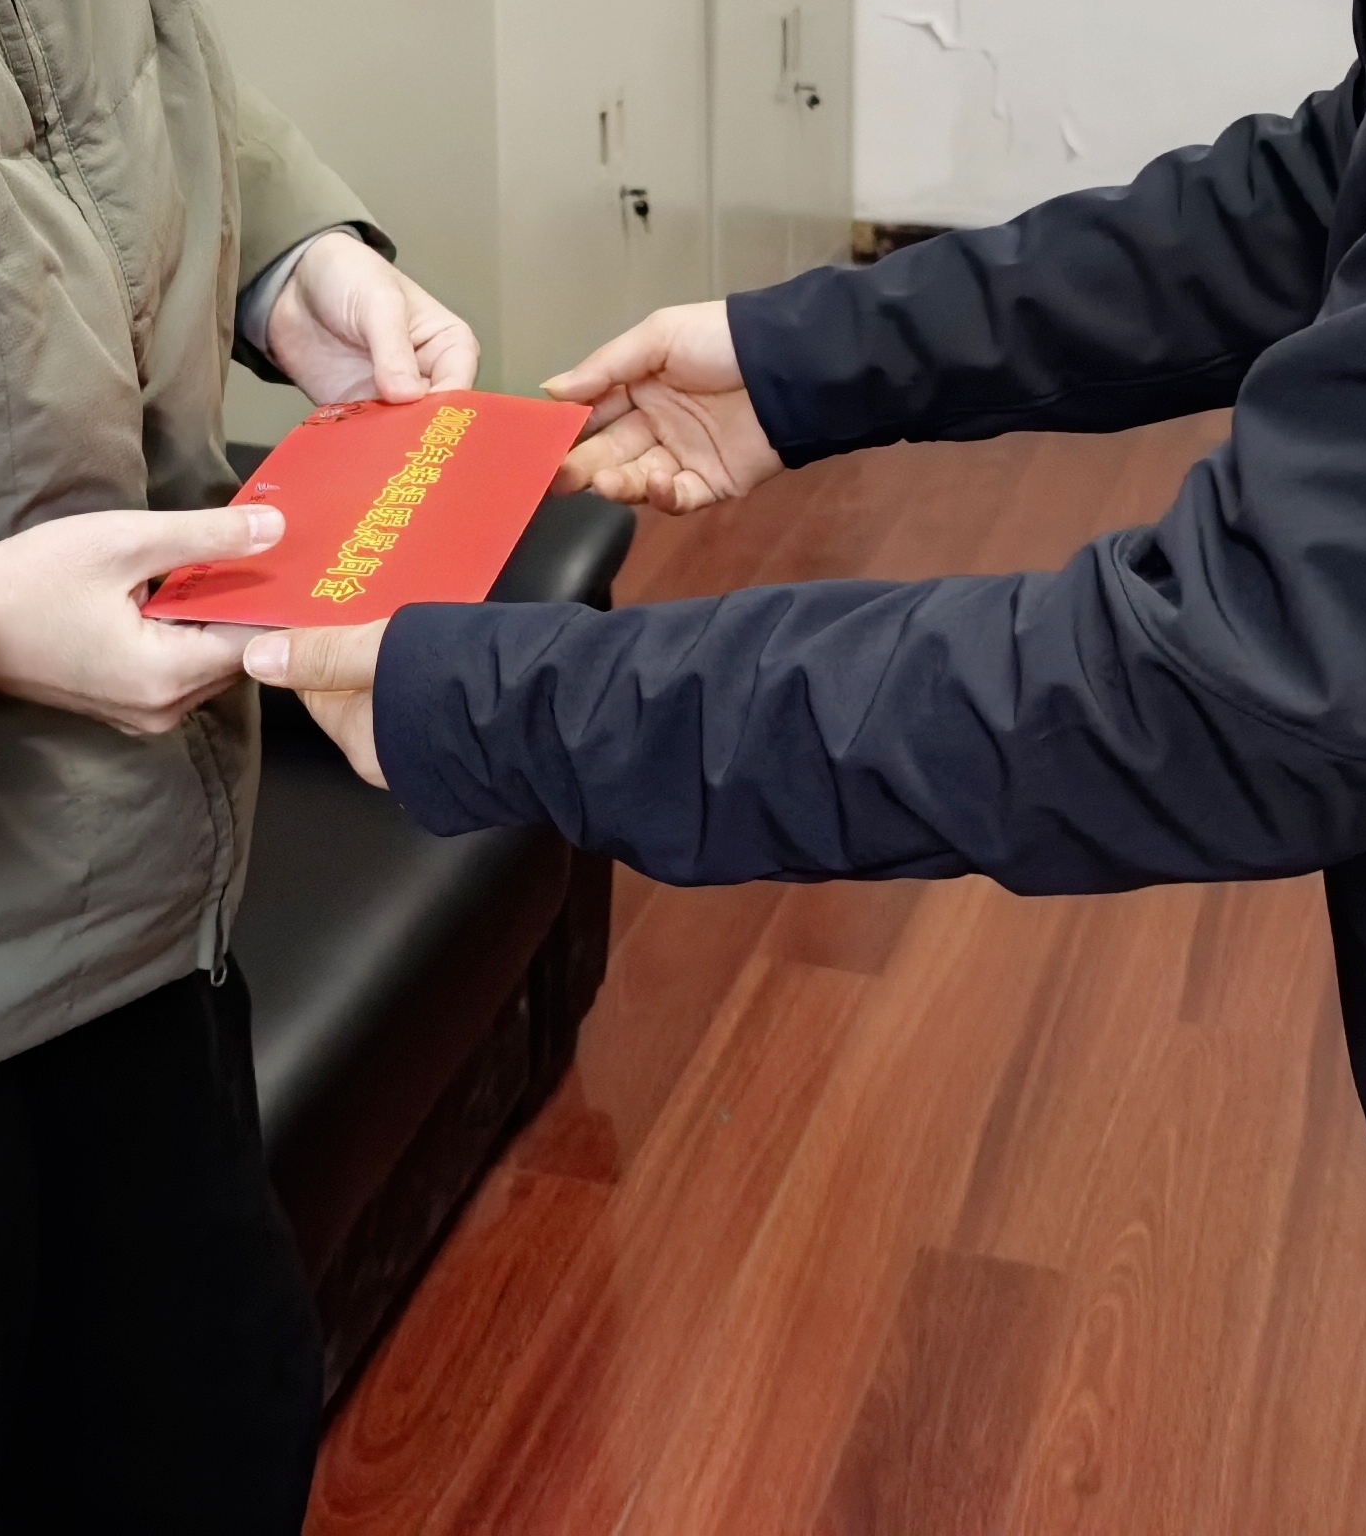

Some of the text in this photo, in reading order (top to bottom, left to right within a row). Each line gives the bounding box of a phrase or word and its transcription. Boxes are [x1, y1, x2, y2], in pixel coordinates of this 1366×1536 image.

[311, 406, 477, 602] 2025年送温暖慰问金
